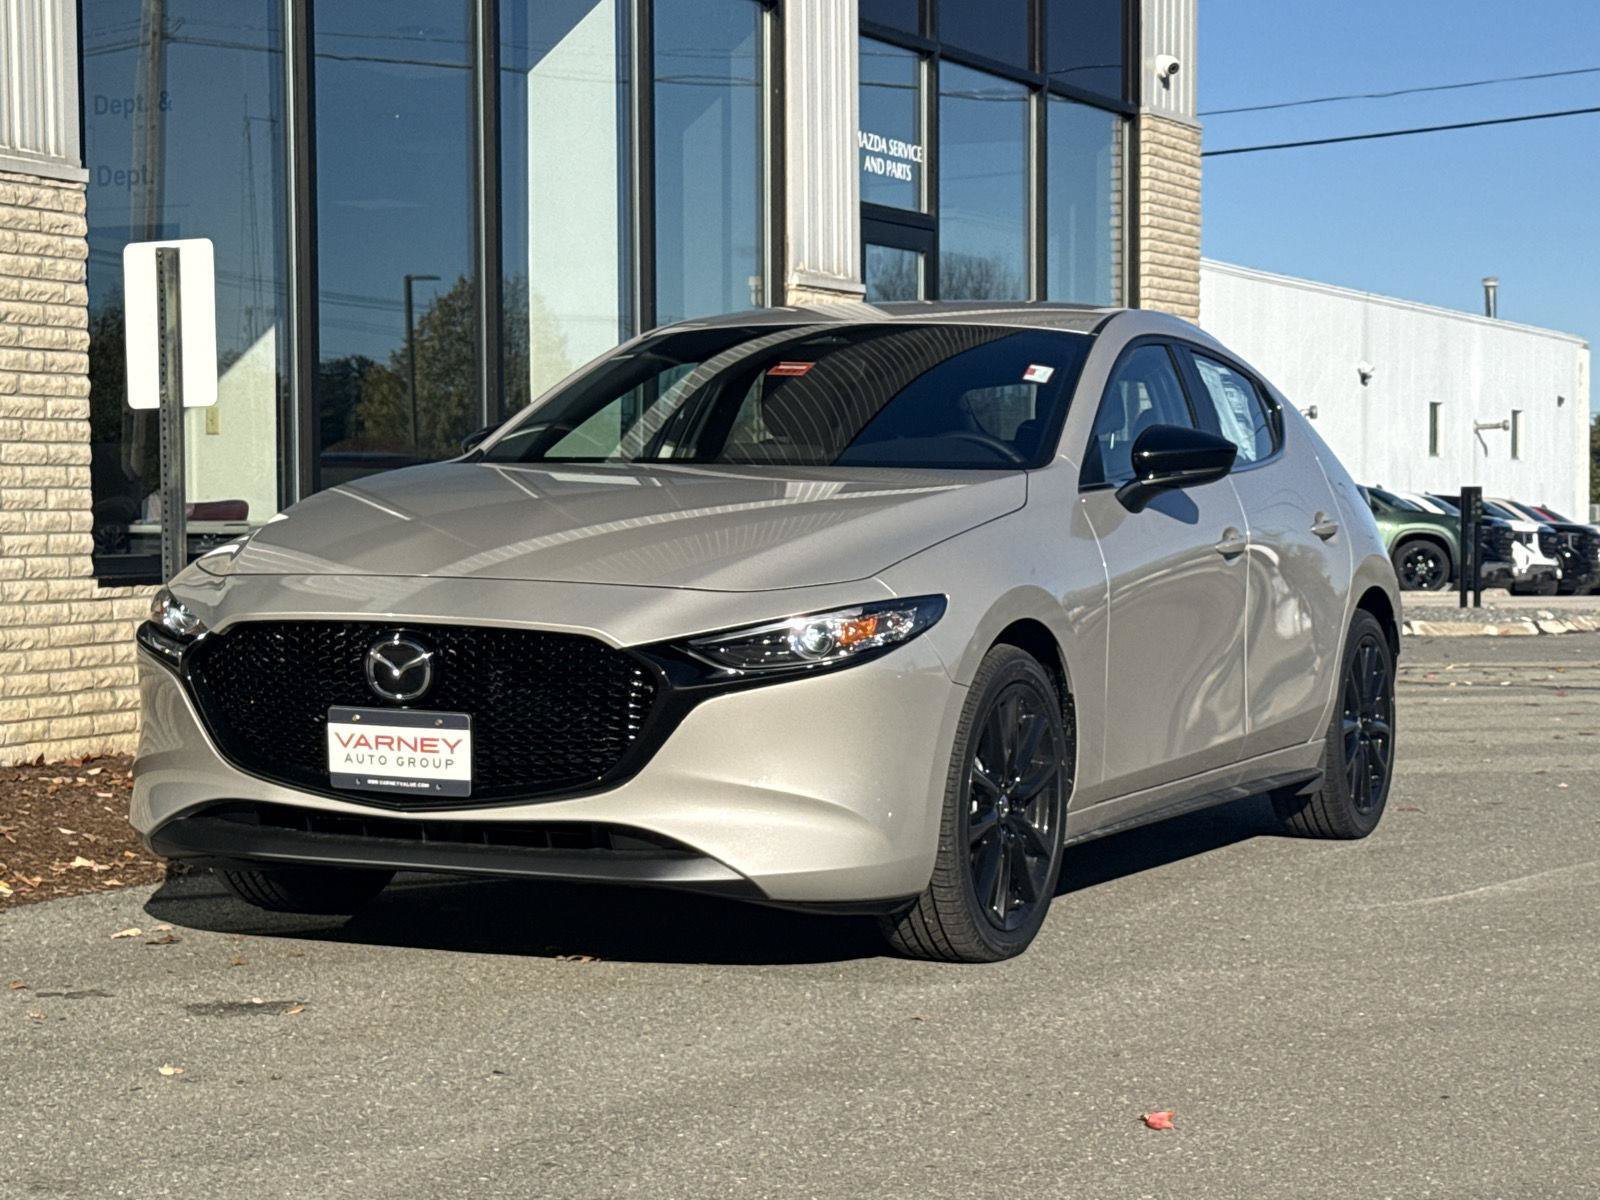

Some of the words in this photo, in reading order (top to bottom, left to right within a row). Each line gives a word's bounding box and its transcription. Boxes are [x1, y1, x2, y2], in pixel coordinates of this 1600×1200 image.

[94, 93, 148, 119] Dept.
[158, 90, 173, 112] &
[888, 138, 923, 163] SERVICE
[864, 155, 885, 175] AND
[886, 159, 912, 182] PARTS
[334, 731, 463, 754] VARNEY
[344, 753, 388, 766] AUTO
[396, 756, 455, 770] GROUP
